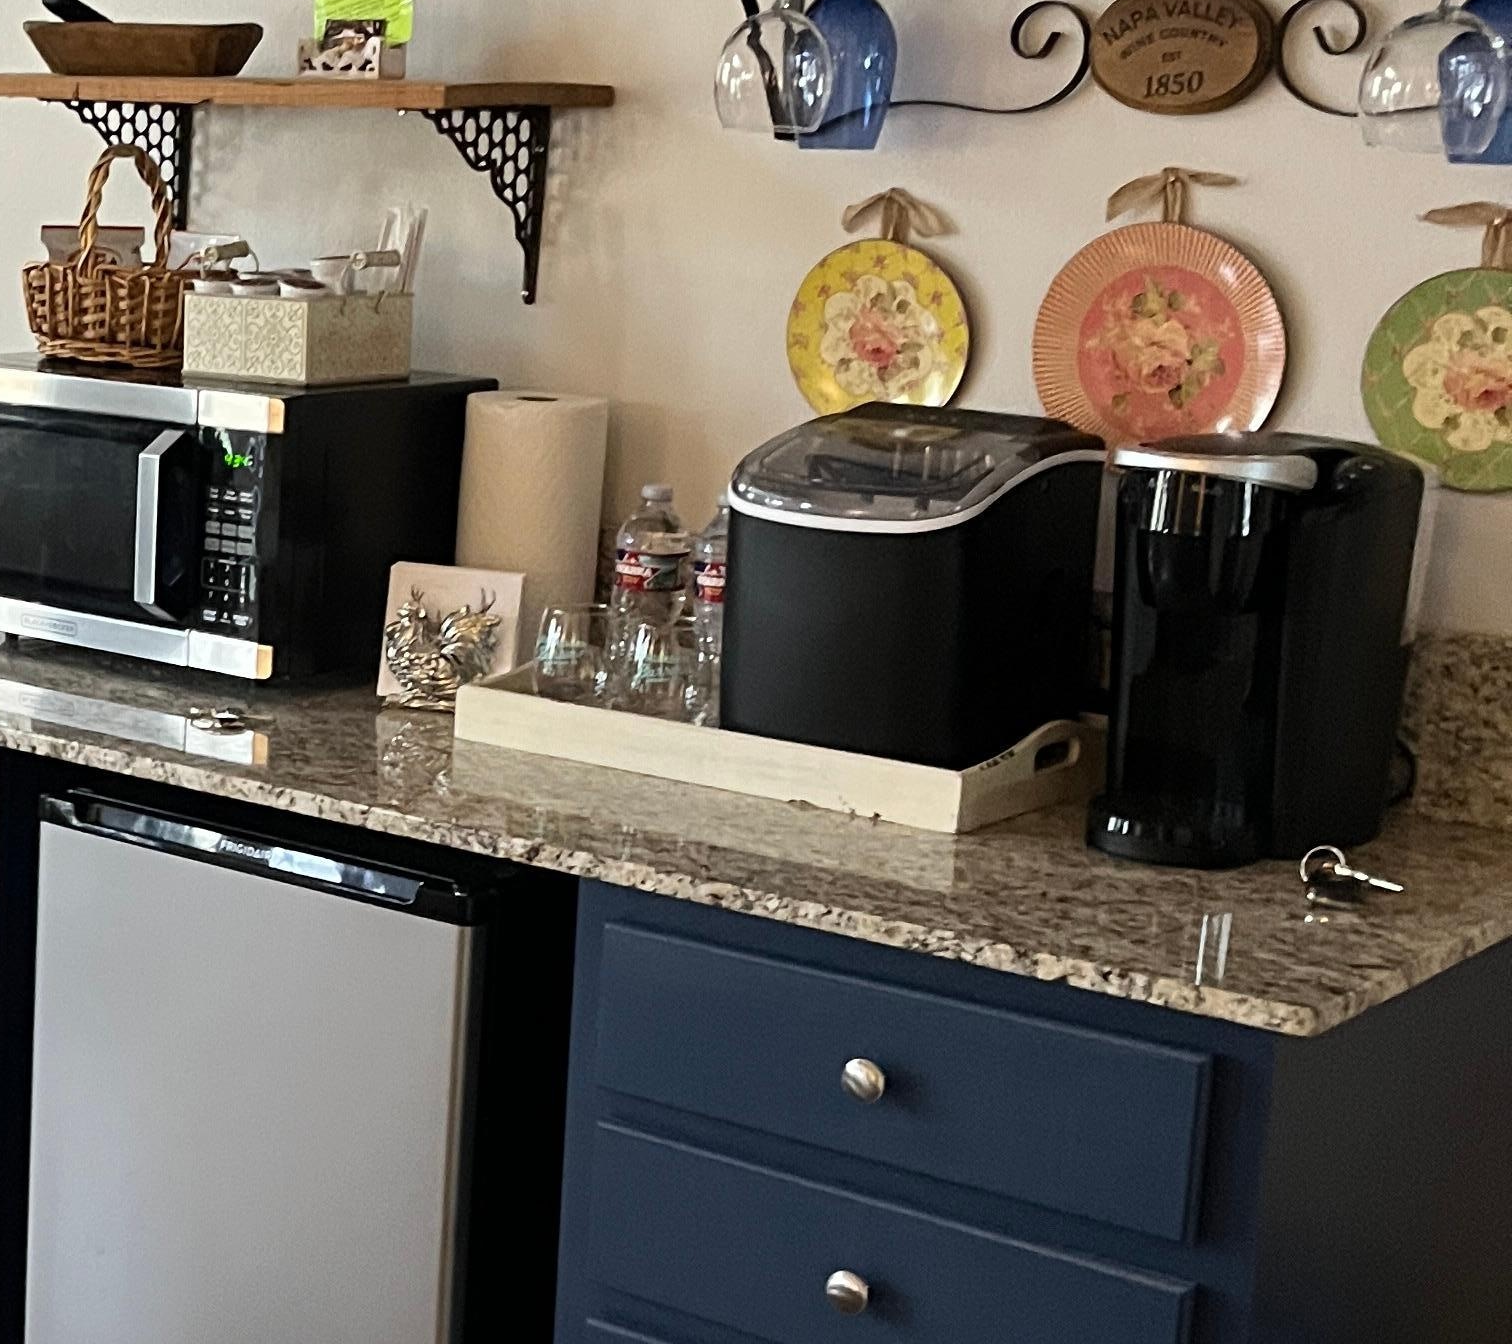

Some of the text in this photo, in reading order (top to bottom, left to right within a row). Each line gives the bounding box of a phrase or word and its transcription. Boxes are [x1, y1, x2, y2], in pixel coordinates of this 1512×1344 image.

[1102, 0, 1243, 45] NAPA VALLEY
[1143, 70, 1204, 98] 1850
